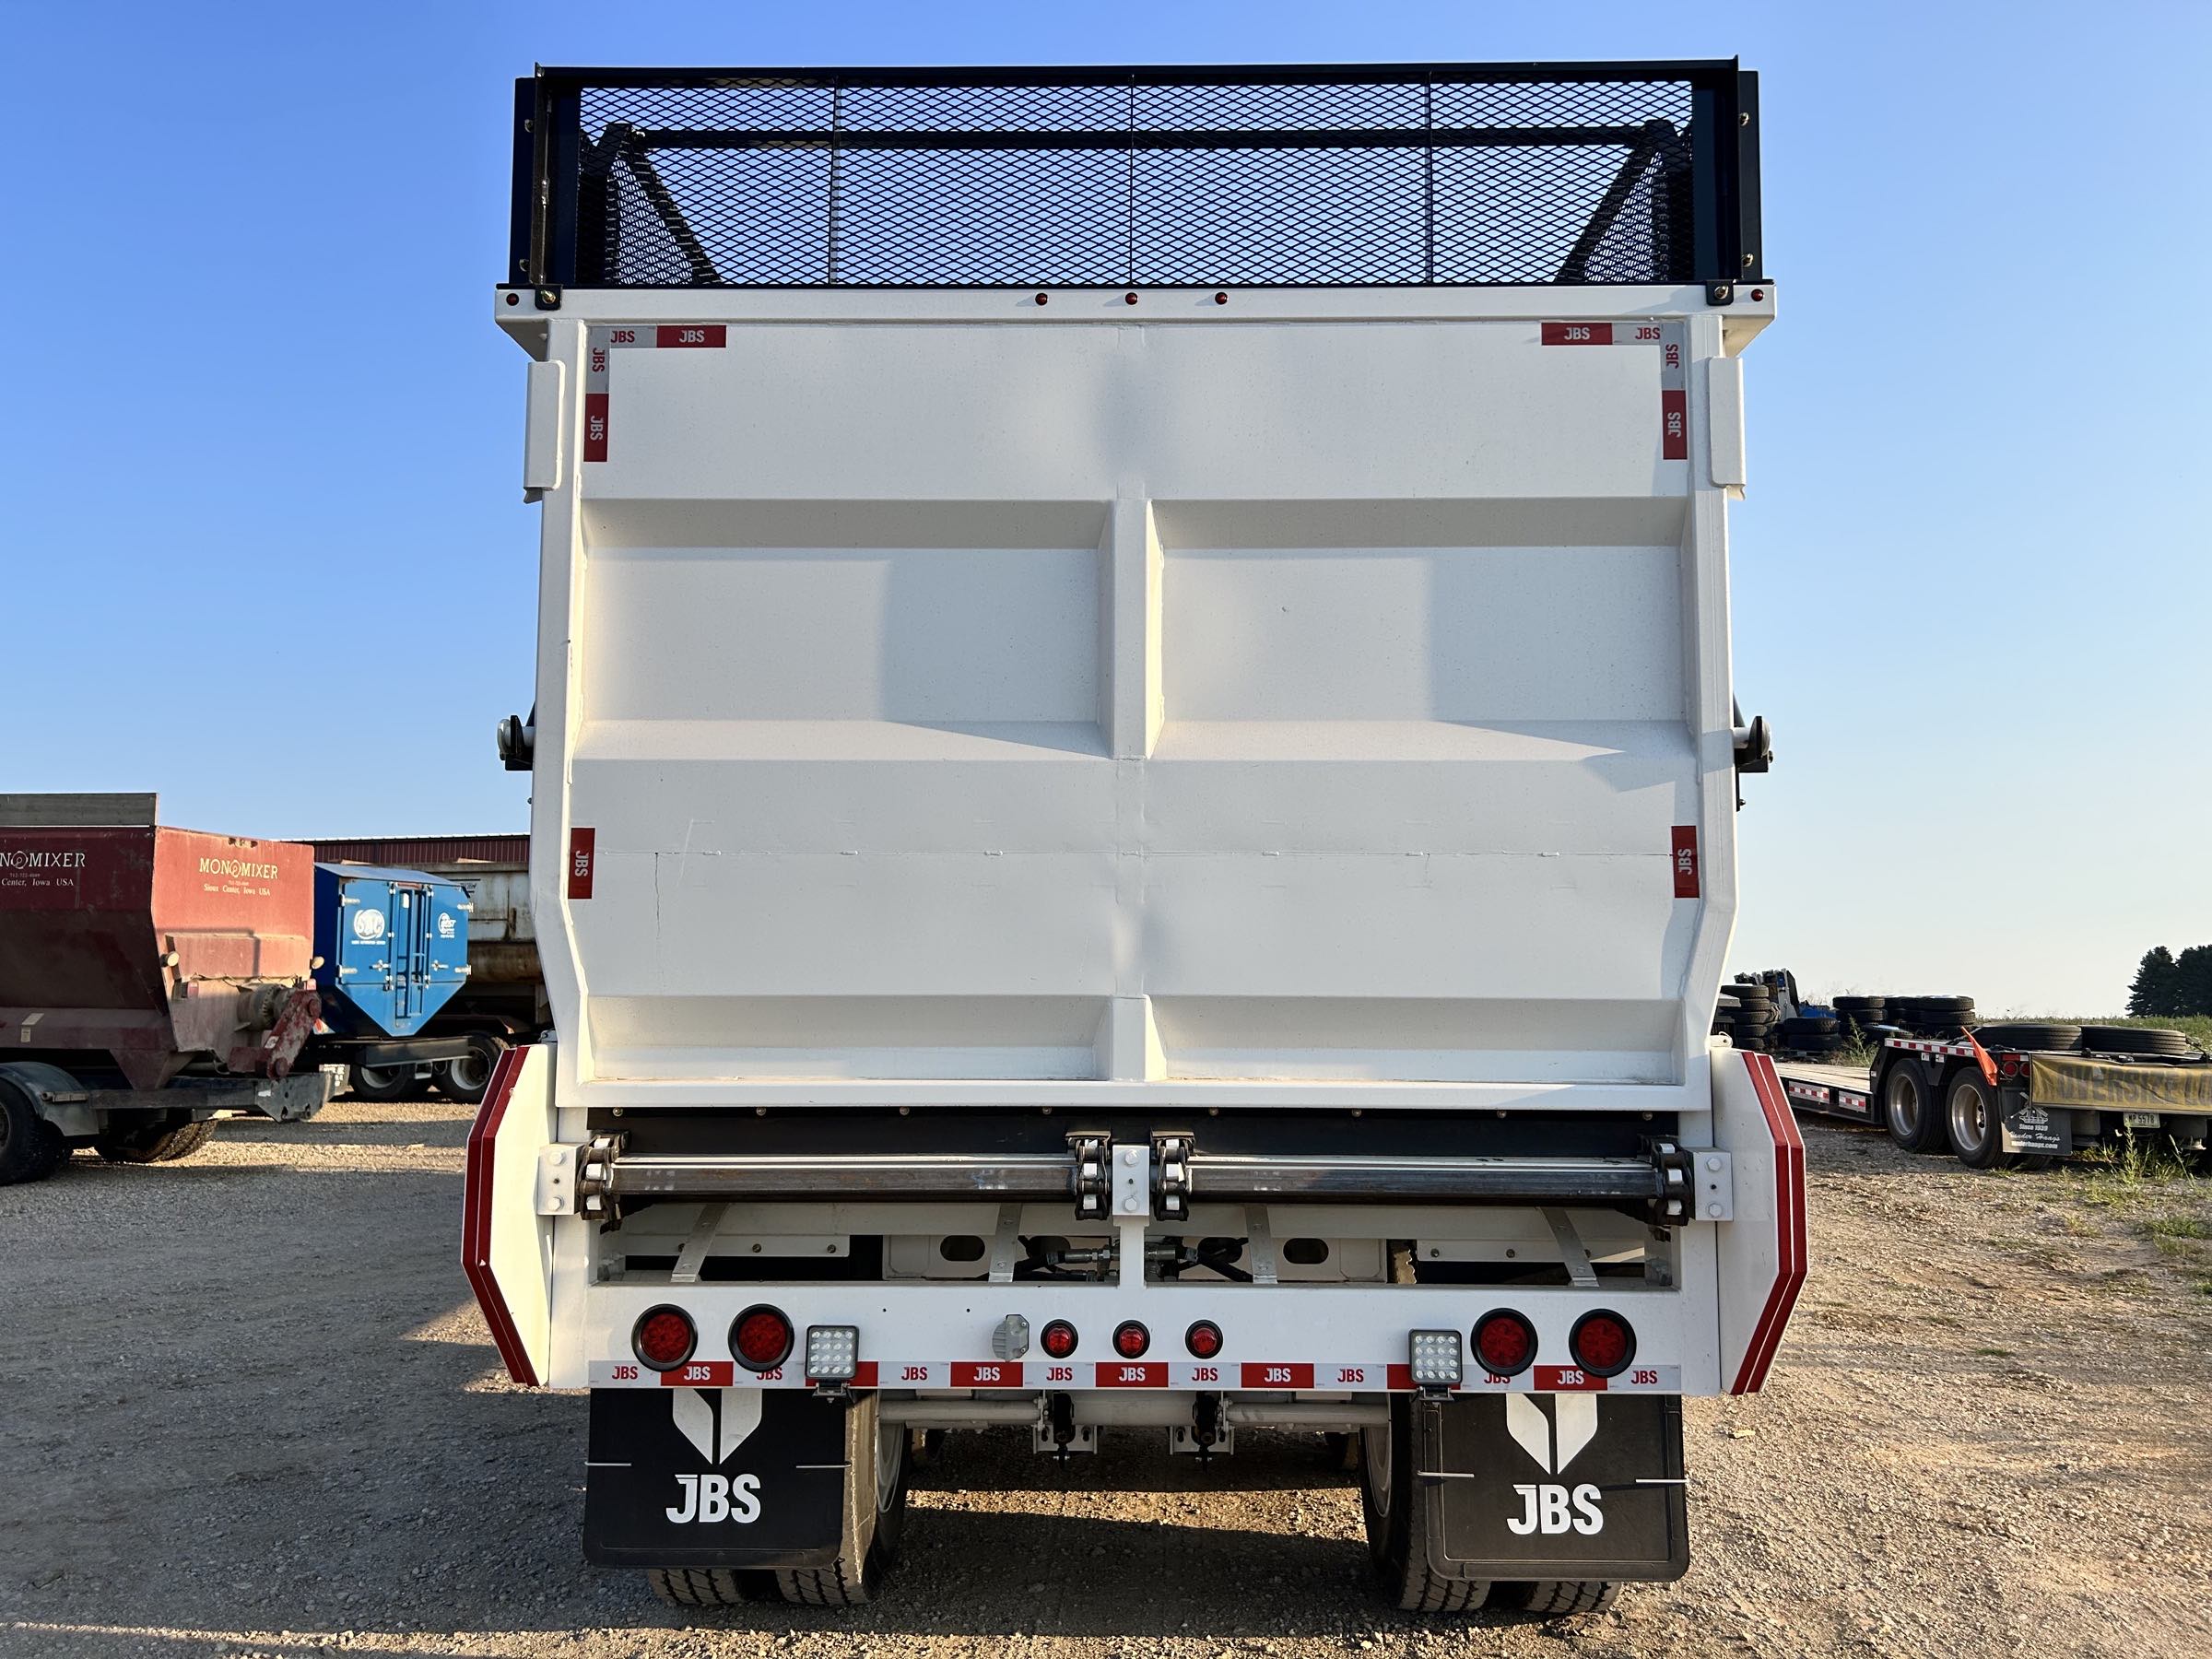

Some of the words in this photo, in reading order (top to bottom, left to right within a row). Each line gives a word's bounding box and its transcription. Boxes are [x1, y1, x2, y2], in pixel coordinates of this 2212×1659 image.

[610, 331, 635, 343] JBS
[679, 330, 705, 343] JBS
[1564, 327, 1591, 340] JBS
[1635, 327, 1660, 340] JBS
[592, 347, 606, 372] JBS
[1665, 344, 1679, 369] JBS
[590, 416, 604, 441] JBS
[1667, 412, 1682, 438] JBS
[199, 857, 278, 879] MONOMIXER
[575, 850, 589, 877] JBS
[1677, 848, 1692, 875] JBS
[2, 878, 27, 887] Center,
[56, 877, 74, 886] USA
[243, 887, 256, 895] Iowa
[258, 888, 270, 896] USA
[612, 1366, 638, 1380] JBS
[684, 1366, 711, 1380] JBS
[901, 1367, 928, 1381] JBS
[973, 1367, 1001, 1381] JBS
[1046, 1367, 1073, 1381] JBS
[1119, 1367, 1146, 1382] JBS
[1192, 1368, 1218, 1382] JBS
[1264, 1368, 1291, 1382] JBS
[1337, 1369, 1364, 1382] JBS
[1558, 1370, 1584, 1384] JBS
[1630, 1370, 1658, 1384] JBS
[665, 1474, 761, 1524] JBS
[1506, 1483, 1604, 1535] JBS
